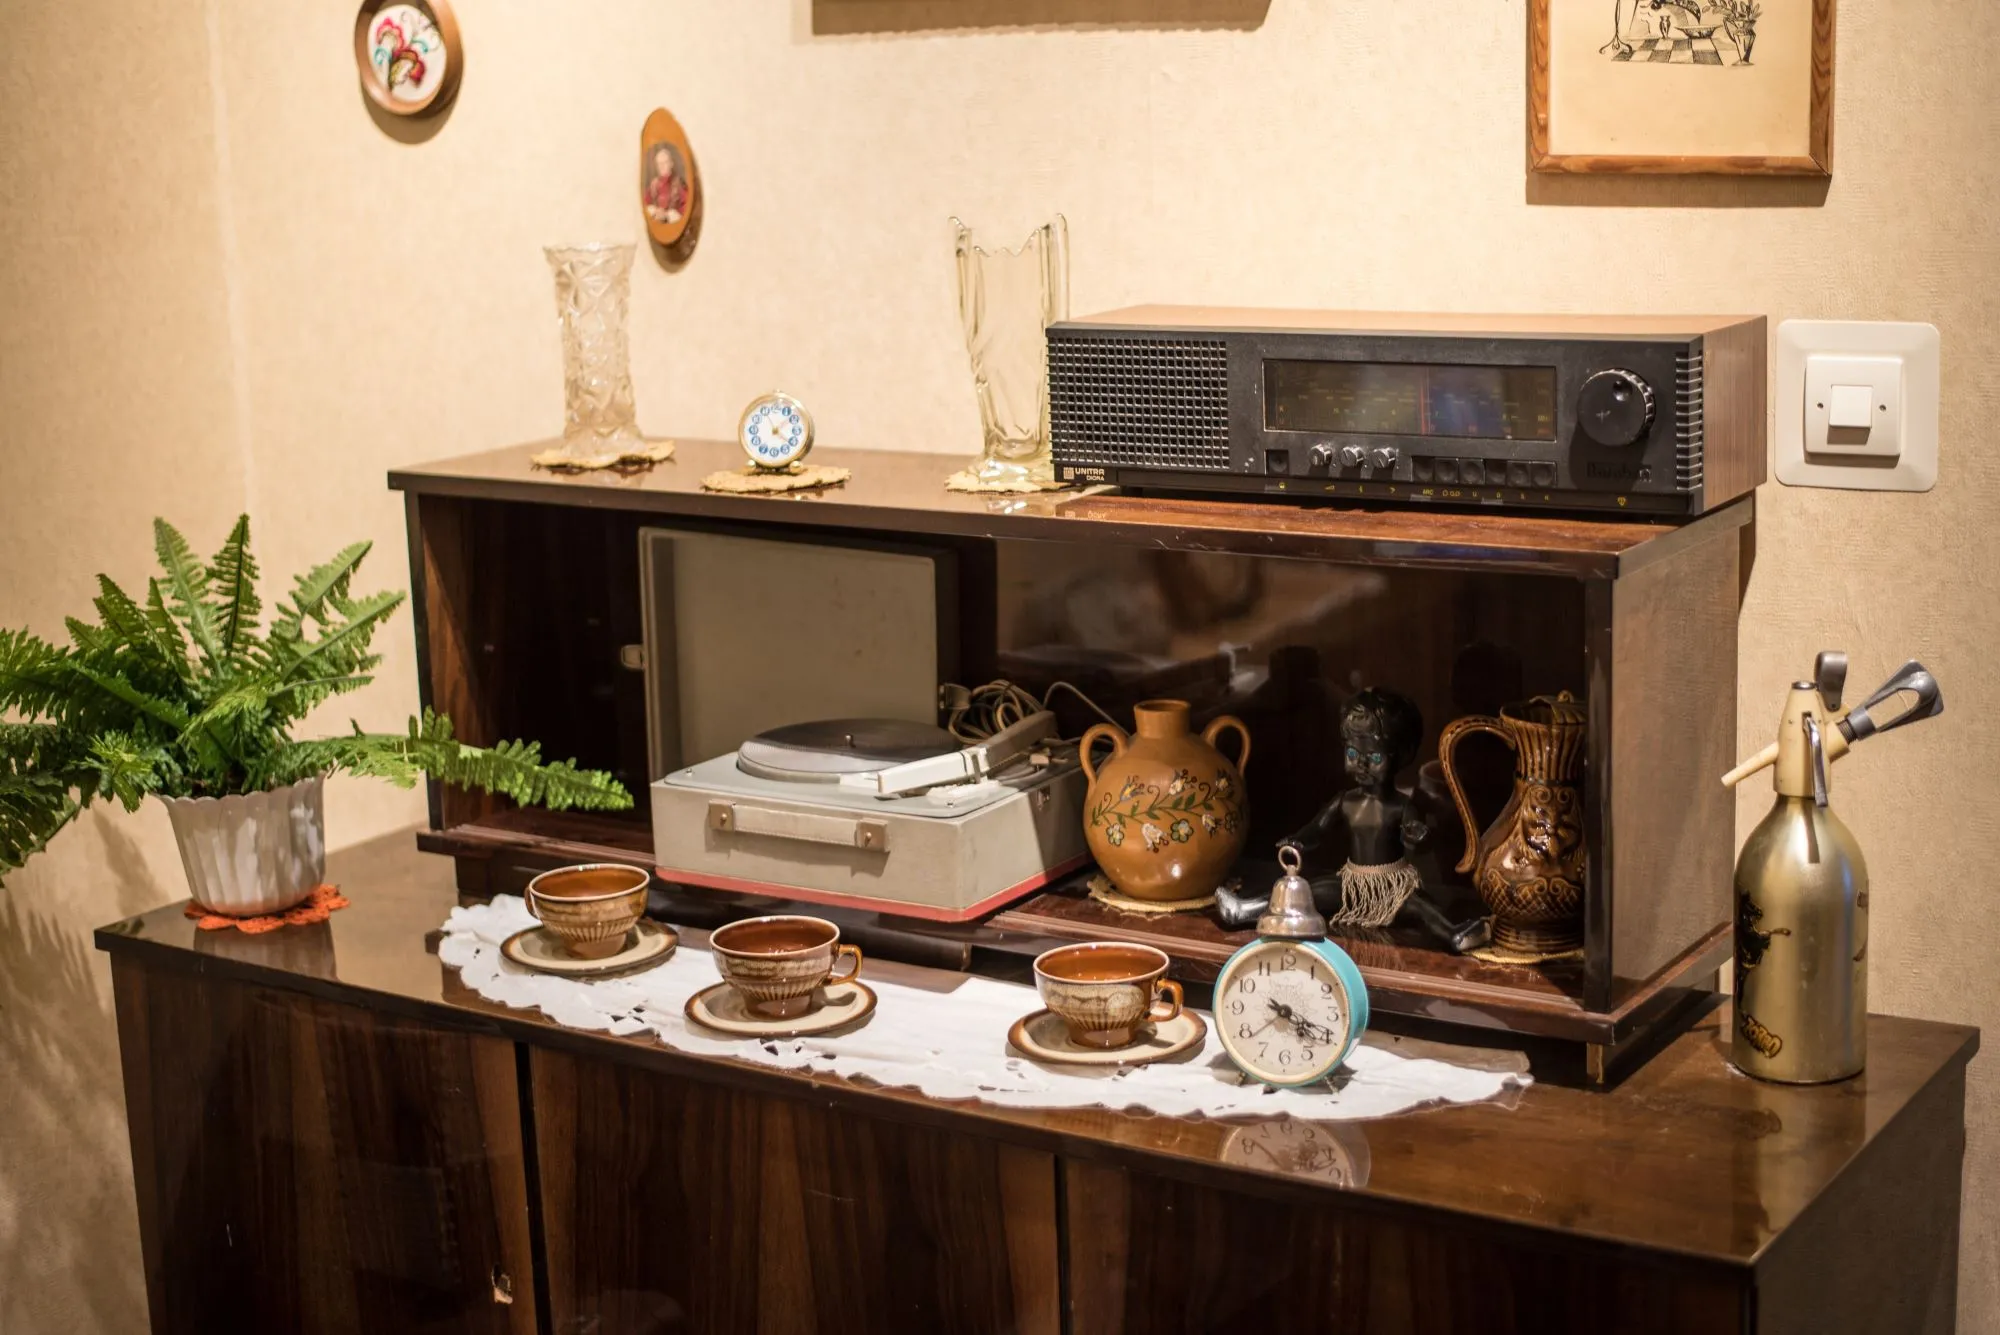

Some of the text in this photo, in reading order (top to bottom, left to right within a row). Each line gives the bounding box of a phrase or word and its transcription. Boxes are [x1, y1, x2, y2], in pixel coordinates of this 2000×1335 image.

[1074, 467, 1105, 475] UNITRA
[1259, 961, 1270, 976] 11
[1280, 955, 1296, 971] 12
[1310, 965, 1315, 979] 1
[1240, 978, 1255, 993] 10
[1321, 983, 1332, 999] 2
[1232, 1000, 1244, 1015] 9
[1327, 1006, 1339, 1022] 3
[1239, 1023, 1252, 1038] 8
[1258, 1042, 1268, 1057] 7
[1279, 1049, 1291, 1065] 6
[1301, 1046, 1314, 1060] 5
